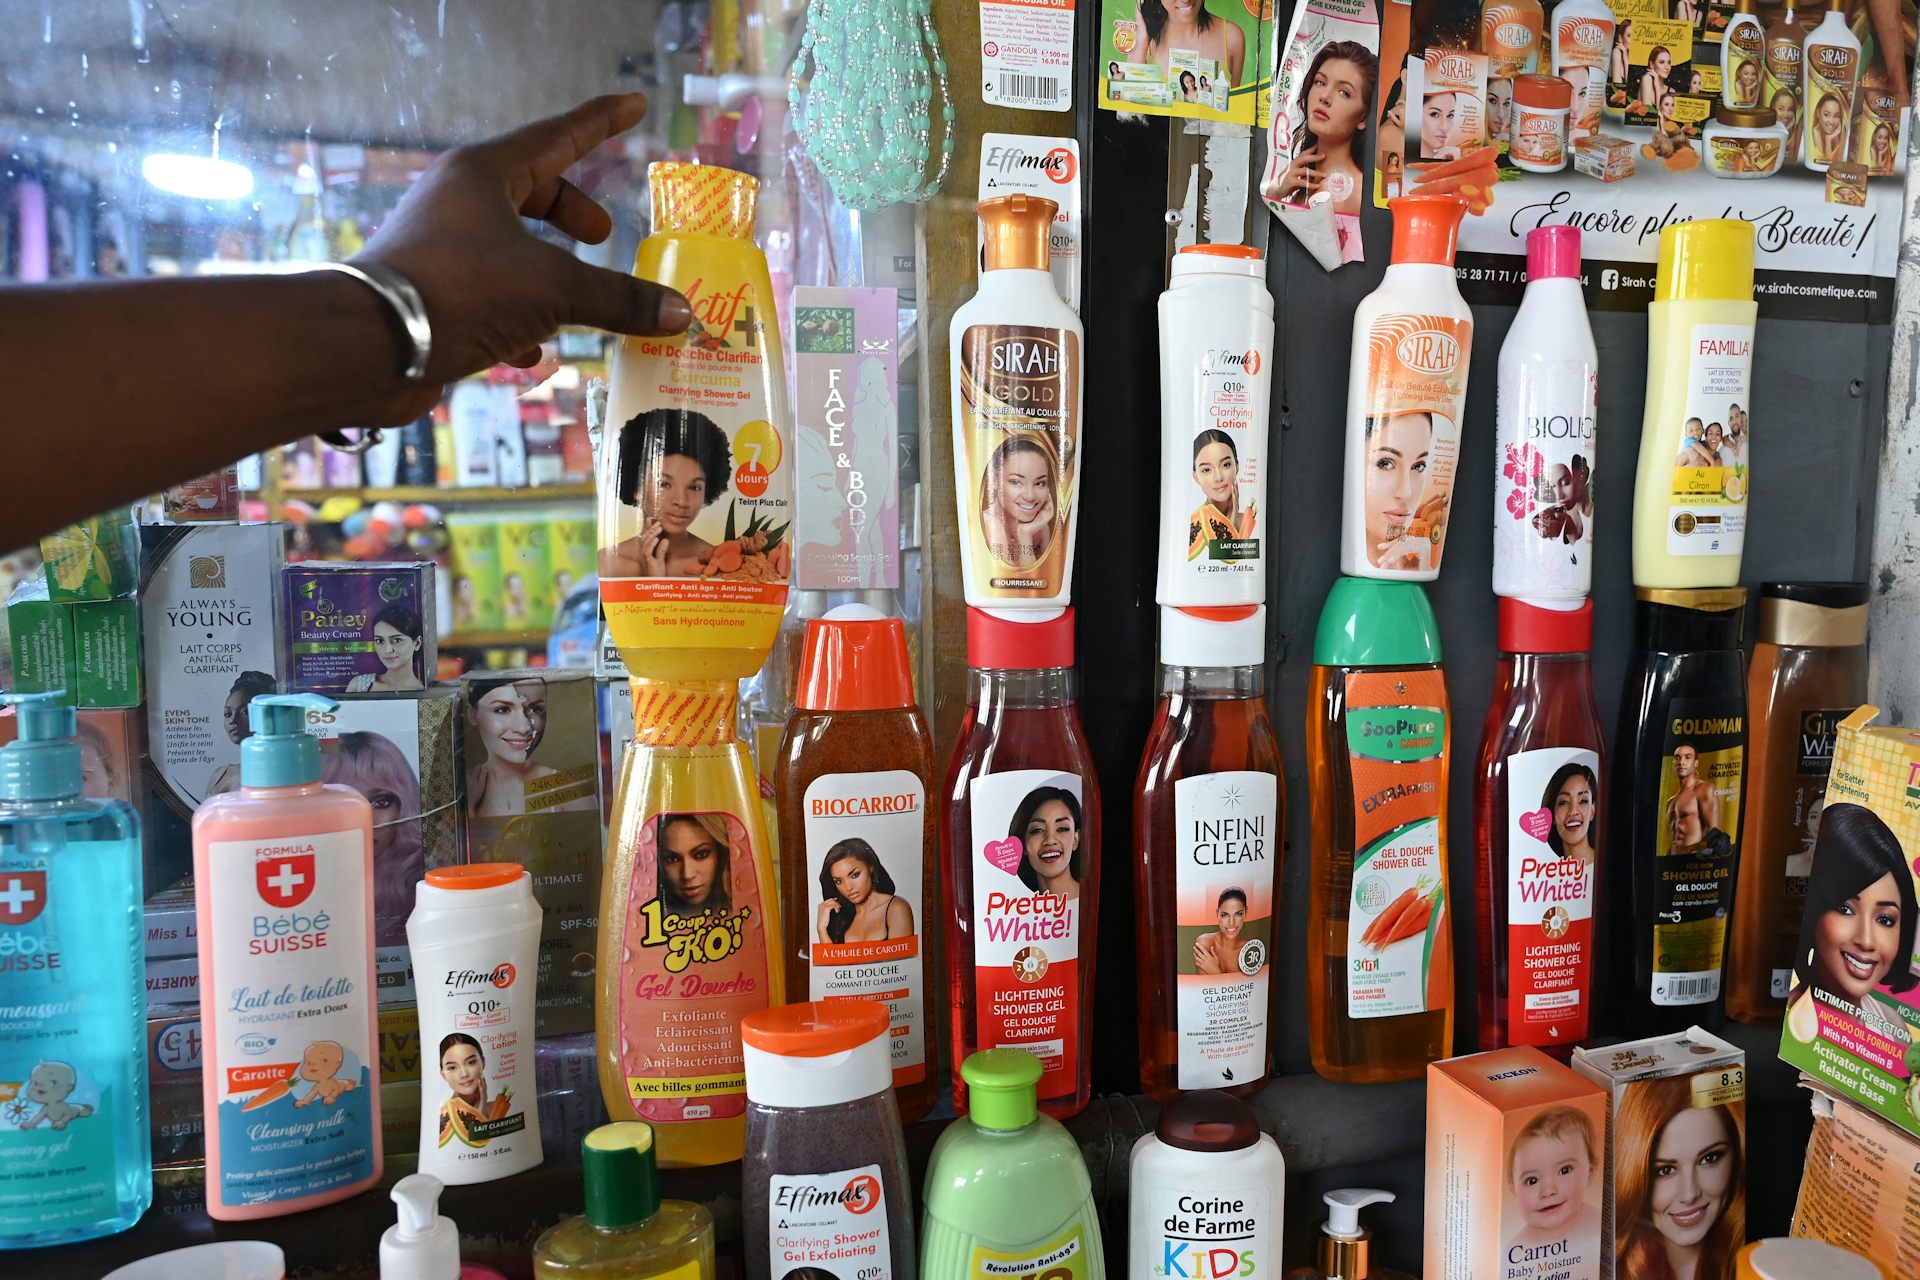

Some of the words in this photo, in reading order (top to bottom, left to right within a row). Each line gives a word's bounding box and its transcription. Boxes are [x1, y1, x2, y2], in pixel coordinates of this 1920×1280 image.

[1324, 4, 1361, 16] EXFOLIANT
[1499, 27, 1532, 46] SIRAH
[1633, 25, 1657, 41] Plus
[1657, 26, 1685, 42] Belle
[1739, 29, 1760, 40] SIRAH
[1001, 45, 1037, 55] GANDOUR
[1774, 46, 1800, 61] SIRAH
[1440, 57, 1475, 80] SIRAH
[1775, 66, 1798, 75] GOLD
[1820, 68, 1845, 79] GOLD
[1528, 119, 1558, 131] SIRAH
[986, 146, 1063, 174] Effimax
[1511, 191, 1637, 237] Encore
[1470, 269, 1482, 280] 28
[1485, 270, 1495, 281] 71
[1499, 271, 1509, 282] 71
[1622, 276, 1652, 290] Sirah
[1754, 282, 1877, 299] w.sirahcosmetique.com
[641, 342, 662, 356] Gel
[1403, 336, 1458, 369] SIRAH
[1699, 340, 1749, 356] FAMILIA
[991, 342, 1058, 374] SIRAH
[671, 368, 741, 389] Curcuma
[704, 388, 735, 399] Shower
[824, 369, 847, 447] FACE
[1217, 418, 1247, 429] Lotion
[836, 453, 851, 468] &
[737, 472, 768, 485] Jours
[1689, 481, 1710, 490] Citron
[847, 471, 867, 544] BODY
[995, 579, 1044, 587] NOURRISSANT
[180, 599, 236, 609] ALWAYS
[166, 611, 252, 627] YOUNG
[300, 609, 368, 630] Parley
[653, 617, 677, 625] Sans
[681, 617, 745, 627] Hydroquinone
[301, 630, 330, 640] Beauty
[332, 630, 361, 639] Cream
[180, 644, 204, 654] LAIT
[206, 643, 242, 654] CORPS
[184, 664, 240, 674] CLARIFIANT
[165, 709, 191, 717] EVENS
[685, 693, 711, 728] Cosmetic
[164, 717, 184, 725] SKIN
[187, 716, 210, 724] TONE
[1360, 719, 1435, 737] SooPure
[188, 732, 212, 740] brunes
[1710, 761, 1741, 770] ACTIVATED
[1708, 770, 1740, 778] CHARCOAL
[1836, 769, 1845, 779] For
[1844, 772, 1865, 787] Better
[811, 793, 914, 816] BIOCARROT
[1193, 815, 1265, 842] INFINI
[256, 844, 315, 857] FORMULA
[1193, 839, 1265, 867] CLEAR
[1382, 848, 1398, 859] GEL
[1400, 845, 1434, 857] DOUCHE
[1372, 857, 1409, 870] SHOWER
[1411, 857, 1428, 867] GEL
[1520, 856, 1585, 879] Pretty
[1662, 870, 1711, 880] SHOWER
[1713, 867, 1729, 878] GEL
[1517, 873, 1588, 903] White!
[1675, 884, 1690, 892] GEL
[1691, 882, 1718, 891] DOUCHE
[986, 891, 1068, 917] Pretty
[253, 909, 331, 938] Bébé
[560, 917, 598, 930] SPF-50
[663, 913, 704, 932] Coup
[984, 909, 1072, 943] White!
[249, 932, 328, 955] SUISSE
[830, 948, 861, 958] L'HUILE
[863, 947, 874, 956] DE
[875, 943, 910, 954] CAROTTE
[1525, 942, 1581, 957] LIGHTENING
[1523, 956, 1565, 969] SHOWER
[1566, 954, 1582, 965] GEL
[834, 969, 853, 980] GEL
[856, 965, 900, 979] DOUCHE
[1532, 971, 1546, 980] GEL
[1547, 967, 1575, 978] DOUCHE
[635, 971, 672, 1000] Gel
[680, 972, 757, 999] Douche
[825, 981, 863, 989] GOMMANT
[1221, 982, 1254, 994] DOUCHE
[1533, 977, 1574, 989] CLARIFIANT
[228, 986, 272, 1013] Lait
[274, 984, 297, 1005] de
[301, 977, 355, 1001] toilette
[994, 985, 1065, 1002] LIGHTENING
[1204, 991, 1253, 1004] CLARIFIANT
[238, 1011, 295, 1025] HYDRATANT
[297, 1007, 322, 1019] Extra
[324, 1003, 348, 1014] Doux
[993, 1002, 1044, 1016] SHOWER
[1045, 999, 1066, 1013] GEL
[1813, 986, 1855, 1015] ULTIMATE
[1855, 1006, 1912, 1043] PROTECTION
[1003, 1018, 1019, 1029] GEL
[1021, 1014, 1057, 1027] DOUCHE
[655, 1024, 734, 1038] Eclaircissant
[1005, 1026, 1055, 1039] CLARIFIANT
[1818, 1009, 1854, 1034] AVOCADO
[1853, 1025, 1867, 1041] OIL
[1866, 1031, 1903, 1060] FORMULA
[491, 1038, 517, 1051] Lotion
[656, 1038, 733, 1054] Adoucissant
[1823, 1025, 1841, 1042] With
[1841, 1032, 1855, 1048] Pro
[1854, 1037, 1885, 1064] Vitamin
[1886, 1059, 1893, 1069] B
[231, 1067, 286, 1082] Carotte
[1488, 1066, 1538, 1083] BECKON
[1812, 1040, 1860, 1077] Activator
[1862, 1067, 1898, 1096] Cream
[1721, 1070, 1743, 1086] 8.3
[1819, 1060, 1858, 1091] Relaxer
[1859, 1083, 1885, 1105] Base
[634, 1082, 661, 1093] Avec
[663, 1080, 692, 1092] billes
[775, 1185, 866, 1213] Effimax
[1178, 1196, 1244, 1214] Corine
[1164, 1215, 1190, 1233] de
[1195, 1218, 1256, 1235] Farme
[776, 1236, 830, 1250] Clarifying
[834, 1228, 881, 1245] Shower
[783, 1250, 805, 1262] Gel
[809, 1244, 876, 1261] Exfoliating
[985, 1262, 1035, 1273] Révolution
[1038, 1242, 1075, 1267] Anti-âge
[1508, 1237, 1568, 1264] Carrot
[1164, 1240, 1256, 1280] KIDS
[1507, 1265, 1535, 1280] Baby
[1537, 1255, 1582, 1273] Moisture
